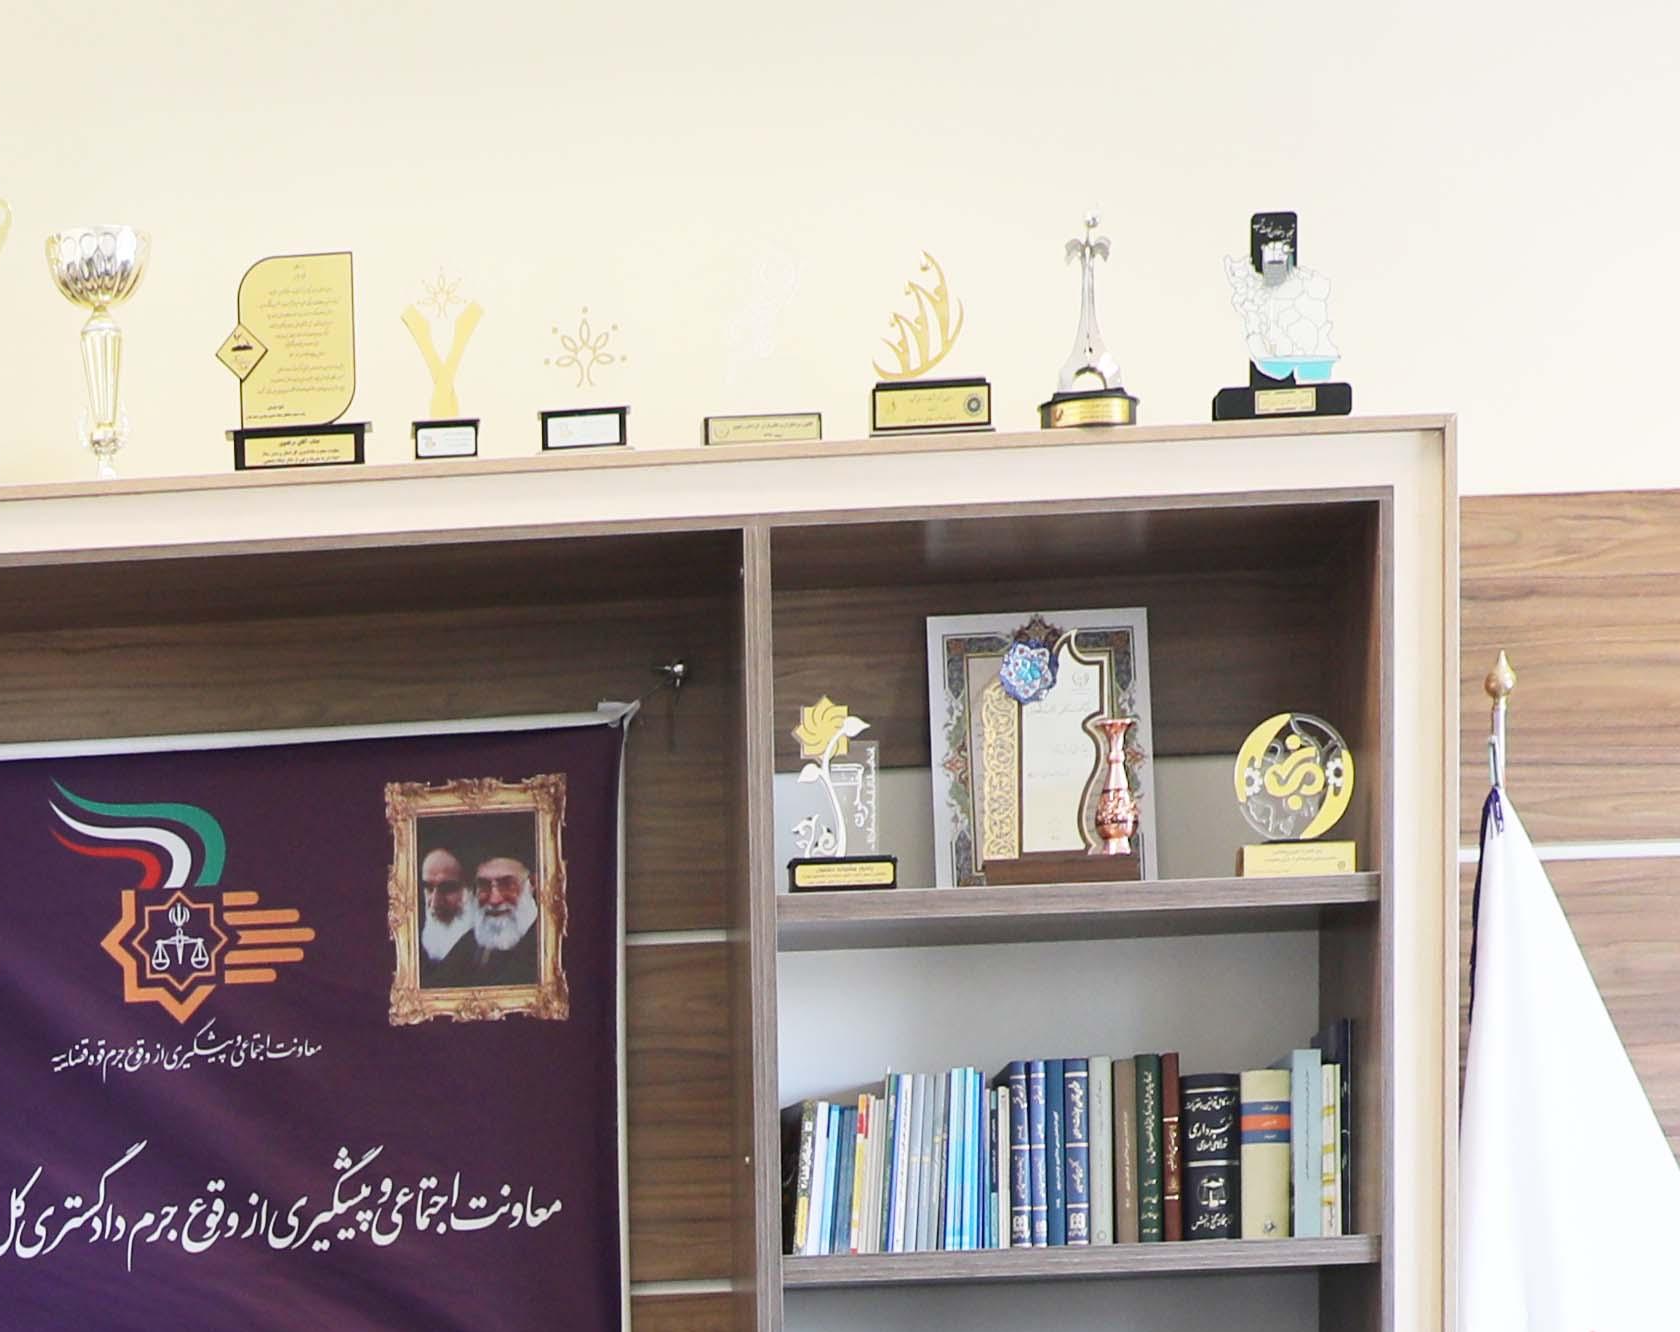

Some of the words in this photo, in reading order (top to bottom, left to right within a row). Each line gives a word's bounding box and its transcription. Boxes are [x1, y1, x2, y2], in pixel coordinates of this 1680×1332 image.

[87, 1040, 105, 1066] قوه
[102, 1047, 127, 1083] جرم
[124, 1040, 150, 1073] وقوع
[154, 1045, 165, 1064] از
[163, 1017, 234, 1070] پیشگیری
[230, 1034, 271, 1067] اجتماعی
[266, 1038, 322, 1060] معاونت
[15, 1140, 147, 1259] دادگستری
[268, 1145, 384, 1251] پیشگیری
[371, 1171, 461, 1246] اجتماعی
[377, 1176, 392, 1204] و
[450, 1184, 562, 1231] معاونت
[127, 1204, 178, 1272] جرم
[181, 1178, 239, 1253] وقوع
[241, 1192, 267, 1238] از
